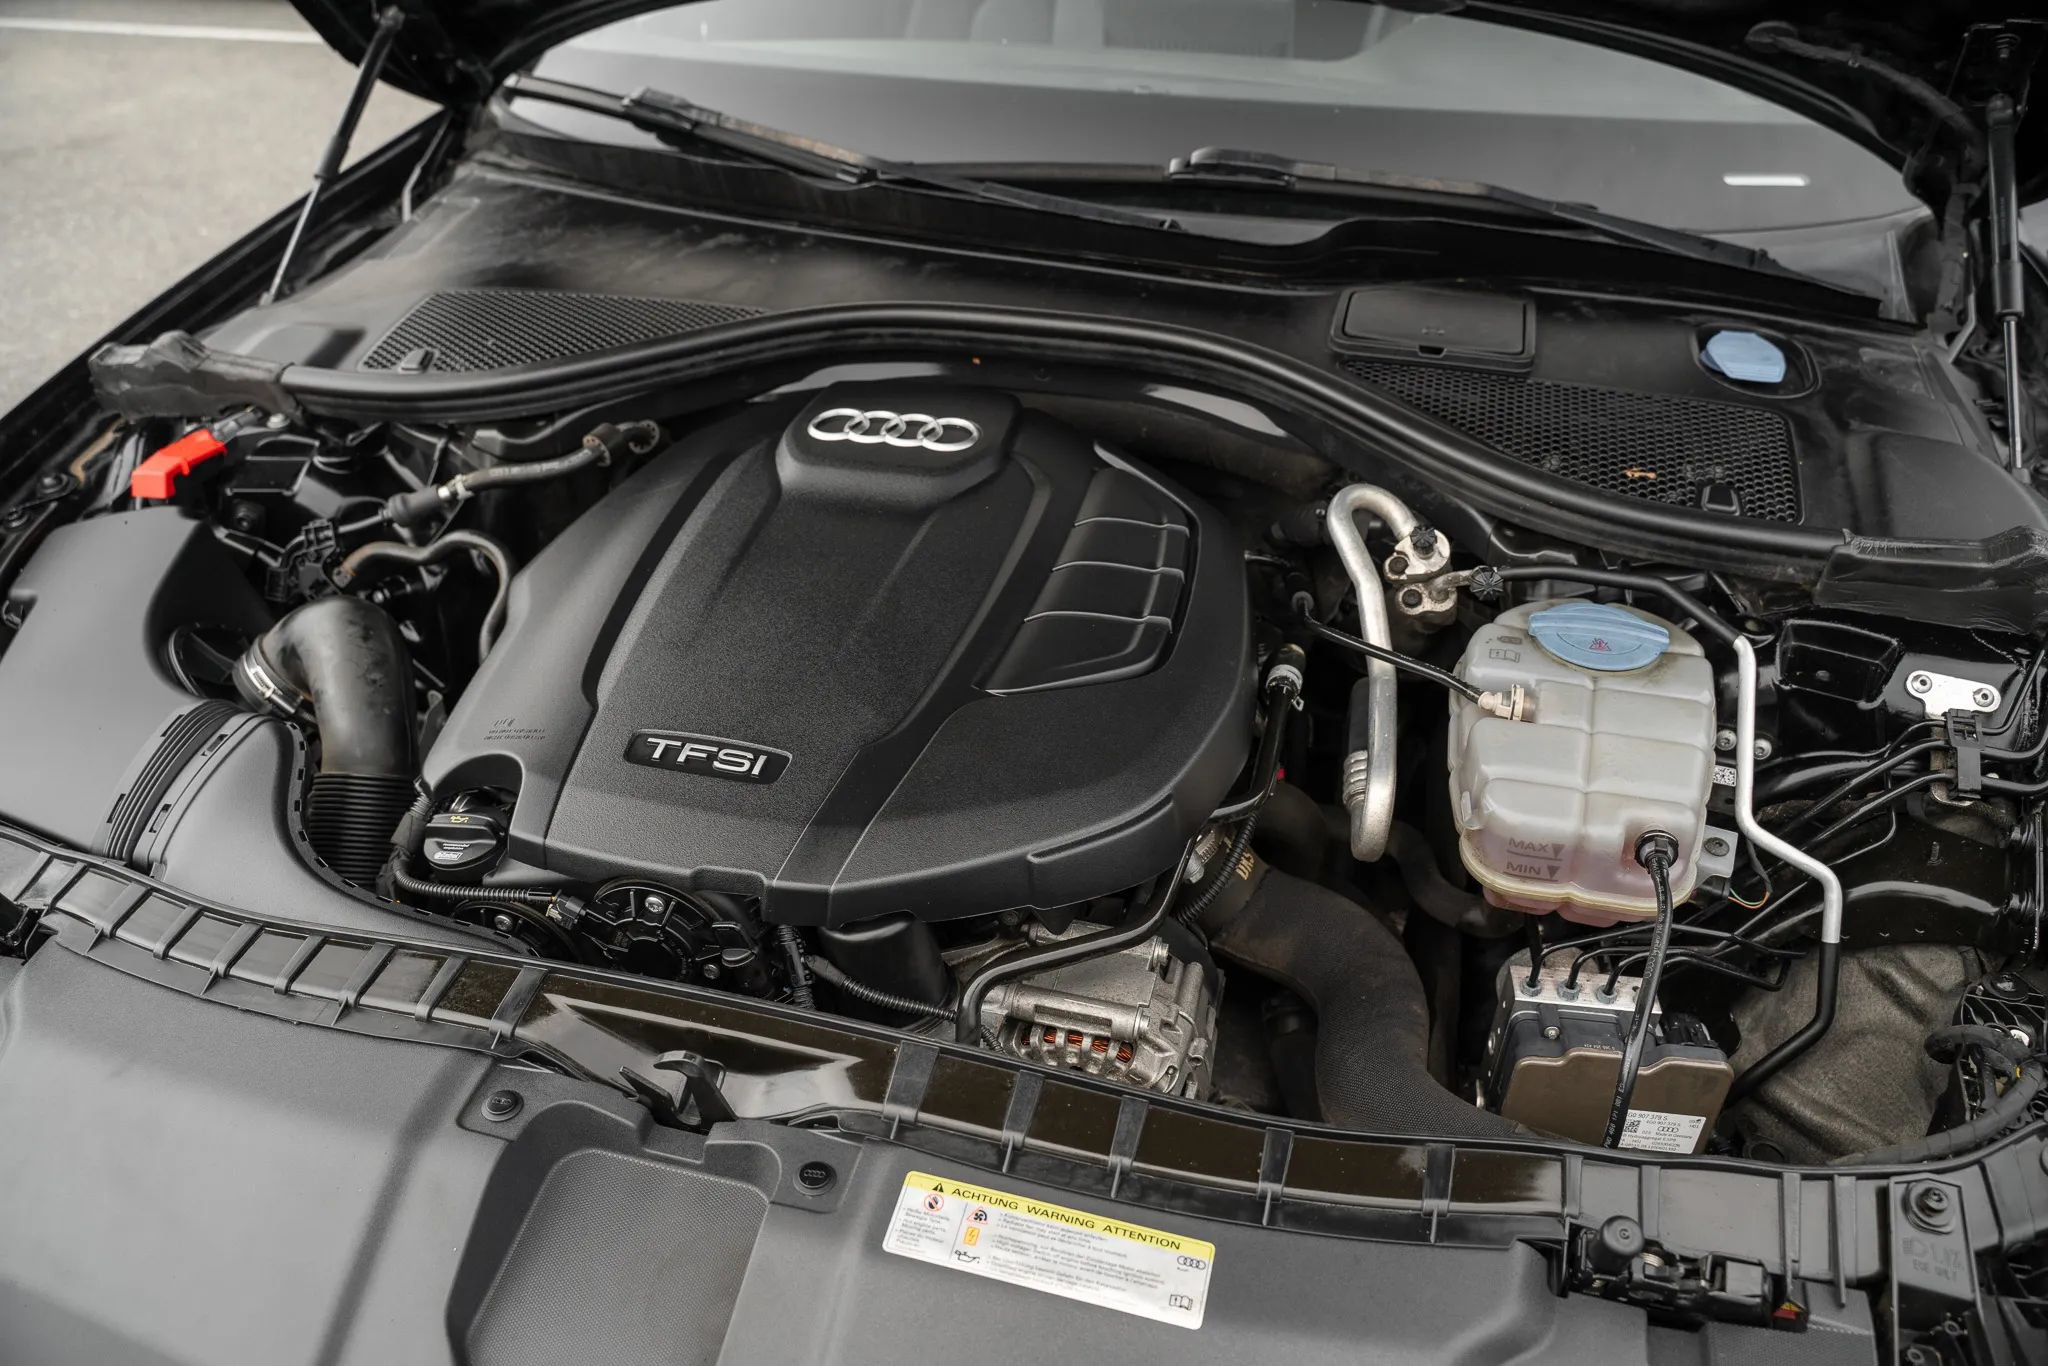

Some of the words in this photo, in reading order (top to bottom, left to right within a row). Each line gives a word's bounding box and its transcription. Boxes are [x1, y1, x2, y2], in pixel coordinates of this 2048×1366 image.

[646, 737, 768, 778] TFSI
[1508, 837, 1547, 853] MAX
[1506, 863, 1543, 876] MIN
[952, 1188, 1018, 1210] ACHTUNG
[1027, 1205, 1095, 1228] WARNING
[1102, 1225, 1181, 1250] ATTENTION
